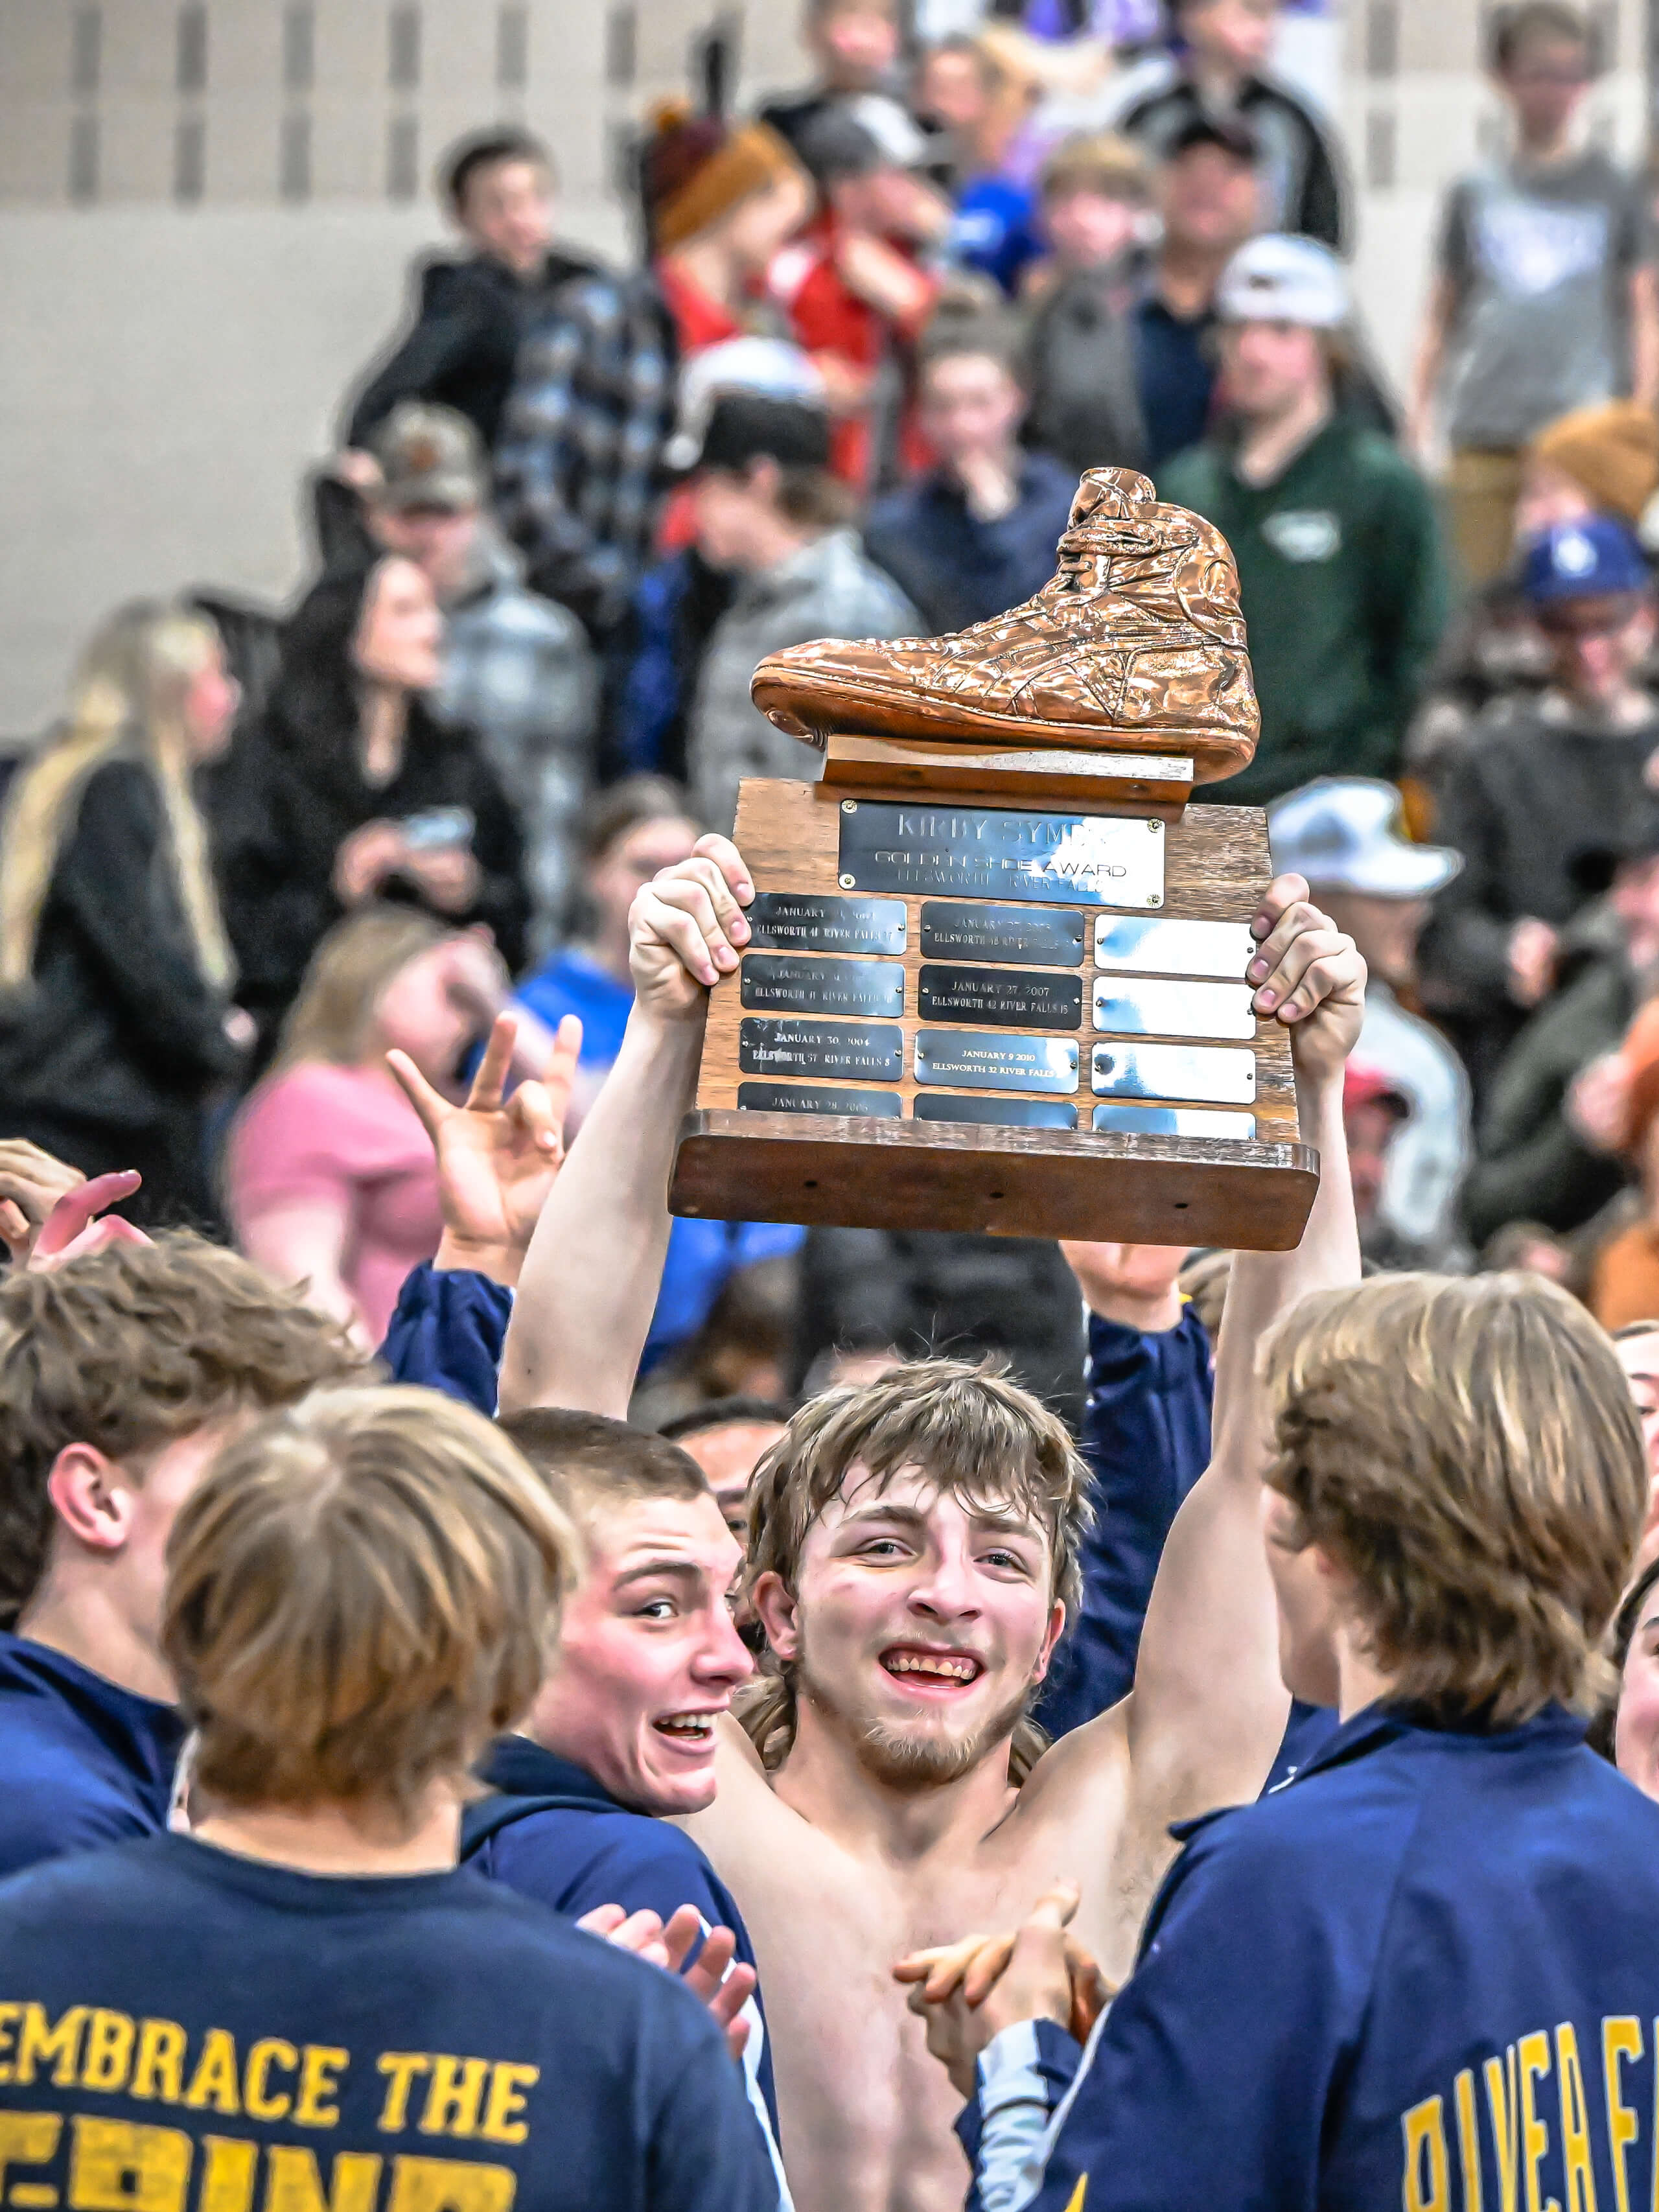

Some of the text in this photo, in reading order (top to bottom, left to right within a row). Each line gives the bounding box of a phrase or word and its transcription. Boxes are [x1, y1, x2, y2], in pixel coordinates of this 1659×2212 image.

[897, 813, 1106, 846] KIRBY SYM
[875, 850, 1128, 878] GOLDEN SHOE AWARD
[1009, 874, 1051, 891] RIVER
[1058, 878, 1104, 894] FALLS
[775, 906, 826, 919] JANUARY
[756, 924, 807, 938] ELLSWORTH
[823, 927, 850, 938] RIVER
[934, 932, 986, 945] ELLSWORTH
[951, 981, 1001, 994] JANUARY
[1025, 984, 1050, 997] 2007
[931, 995, 984, 1009] ELLSWORTH
[1000, 999, 1028, 1012] RIVER
[1030, 1002, 1058, 1014] FALLS
[773, 1031, 822, 1044] JANUARY
[752, 1048, 806, 1064] ELLSWORTH
[824, 1053, 851, 1065] RIVER
[855, 1055, 882, 1067] FALLS
[961, 1049, 1036, 1062] JANUARY 9 2010
[932, 1062, 986, 1074] ELLSWORTH
[999, 1067, 1026, 1076] RIVER
[1028, 1069, 1055, 1078] FALLS
[772, 1097, 820, 1110] JANUARY
[377, 2049, 540, 2146] THE
